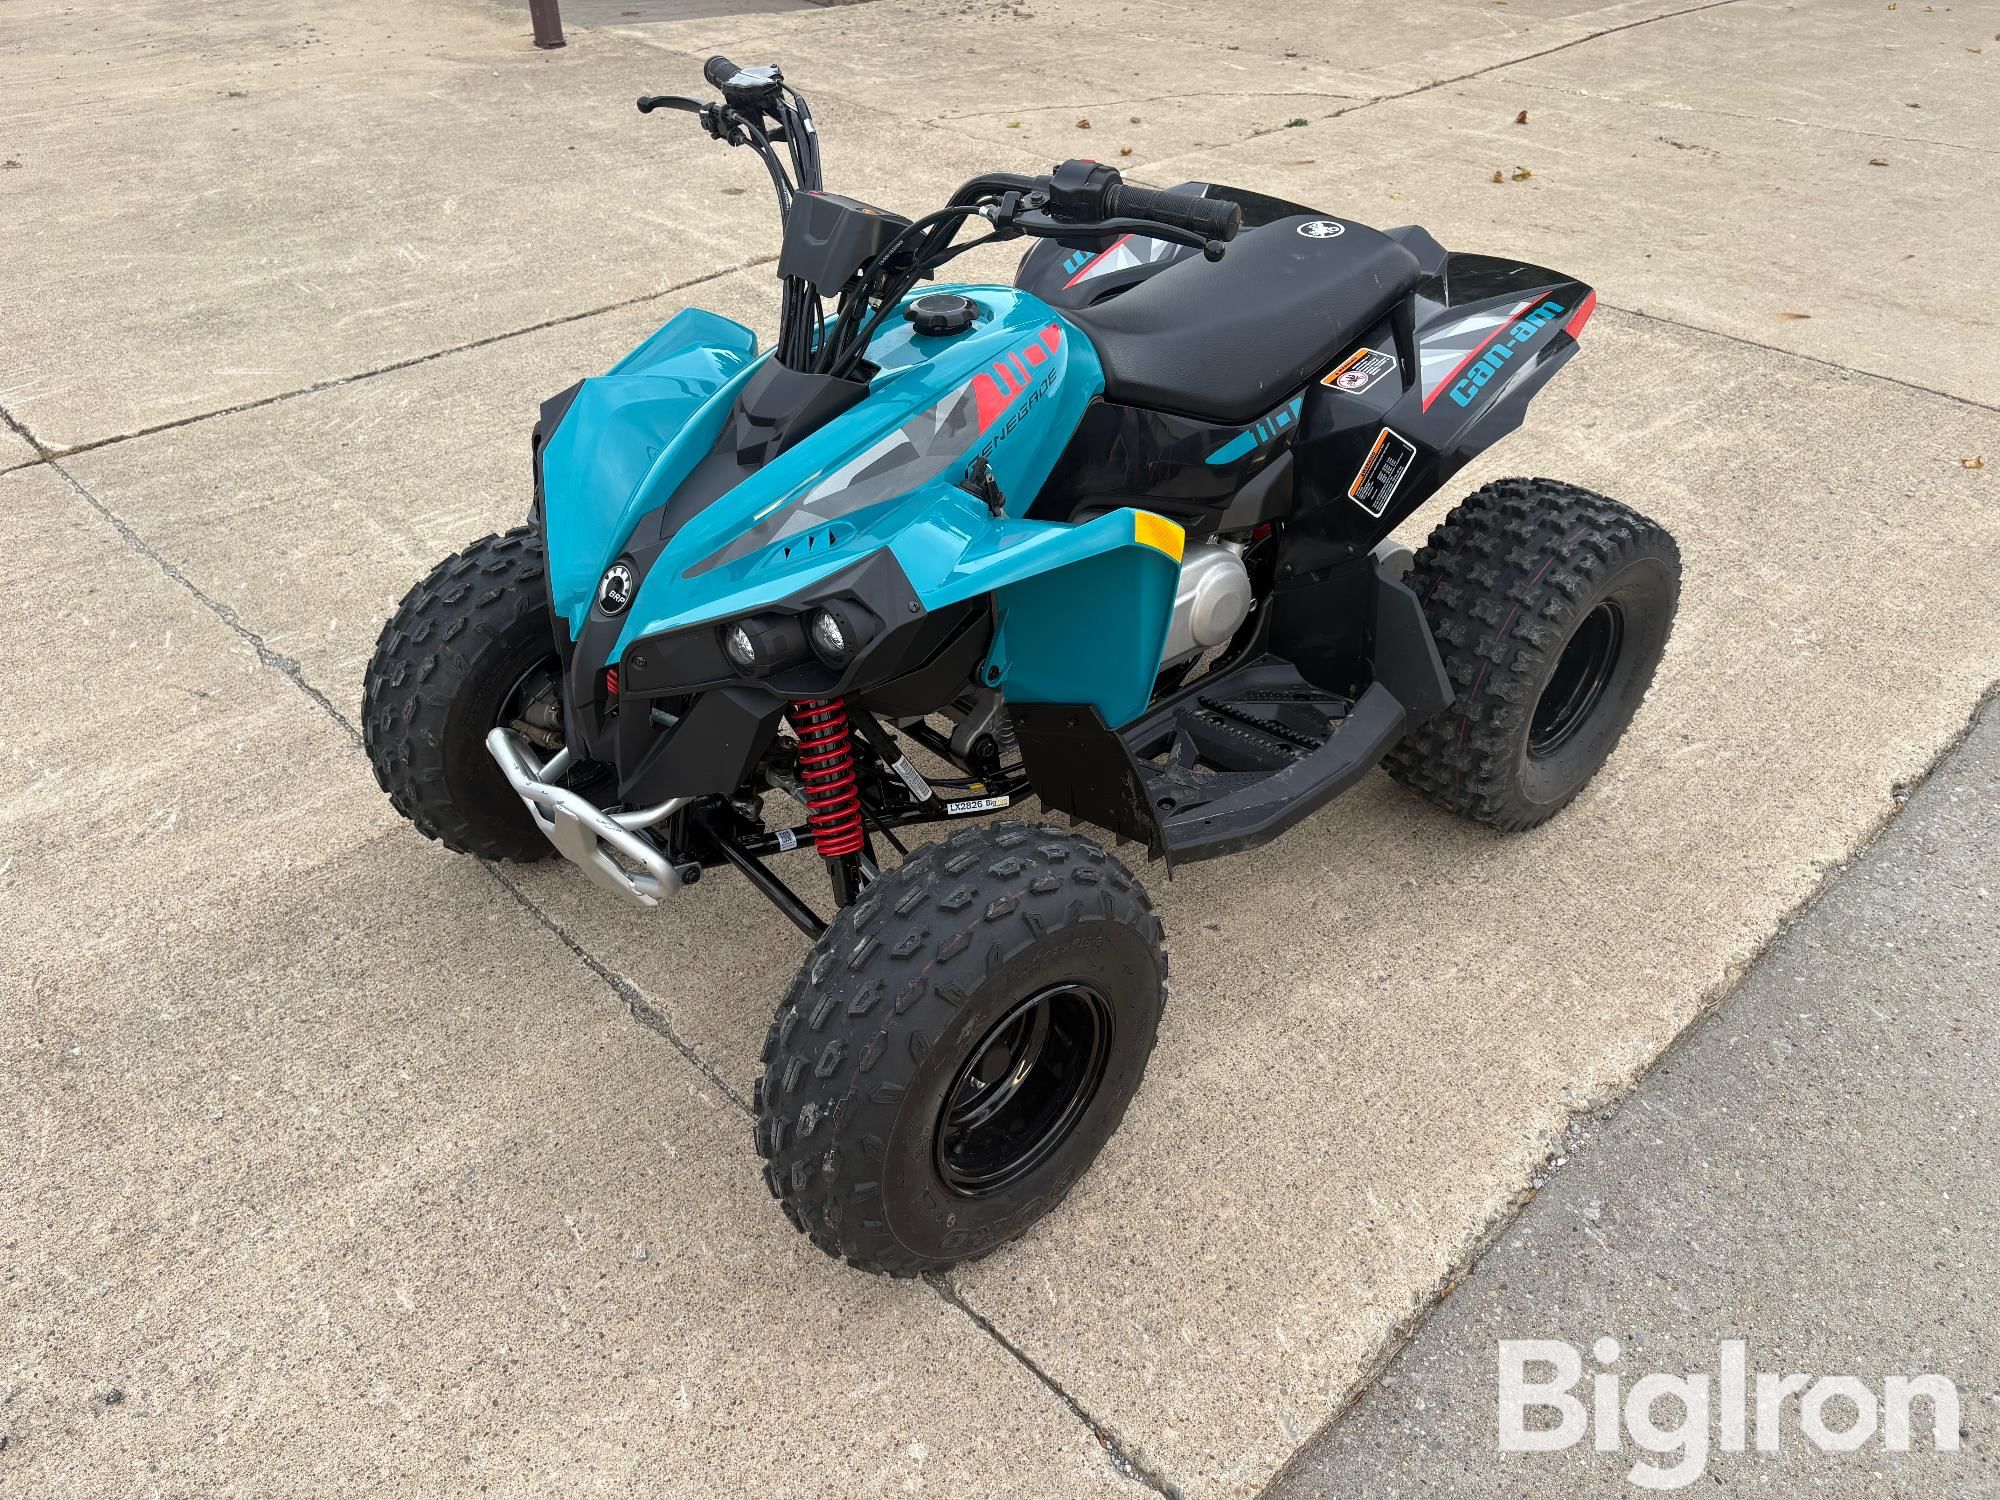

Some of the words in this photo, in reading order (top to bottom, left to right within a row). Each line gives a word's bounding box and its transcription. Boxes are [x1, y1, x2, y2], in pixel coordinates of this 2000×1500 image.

[1449, 301, 1566, 408] can-am
[608, 590, 626, 603] BRP
[950, 800, 983, 811] LX2826
